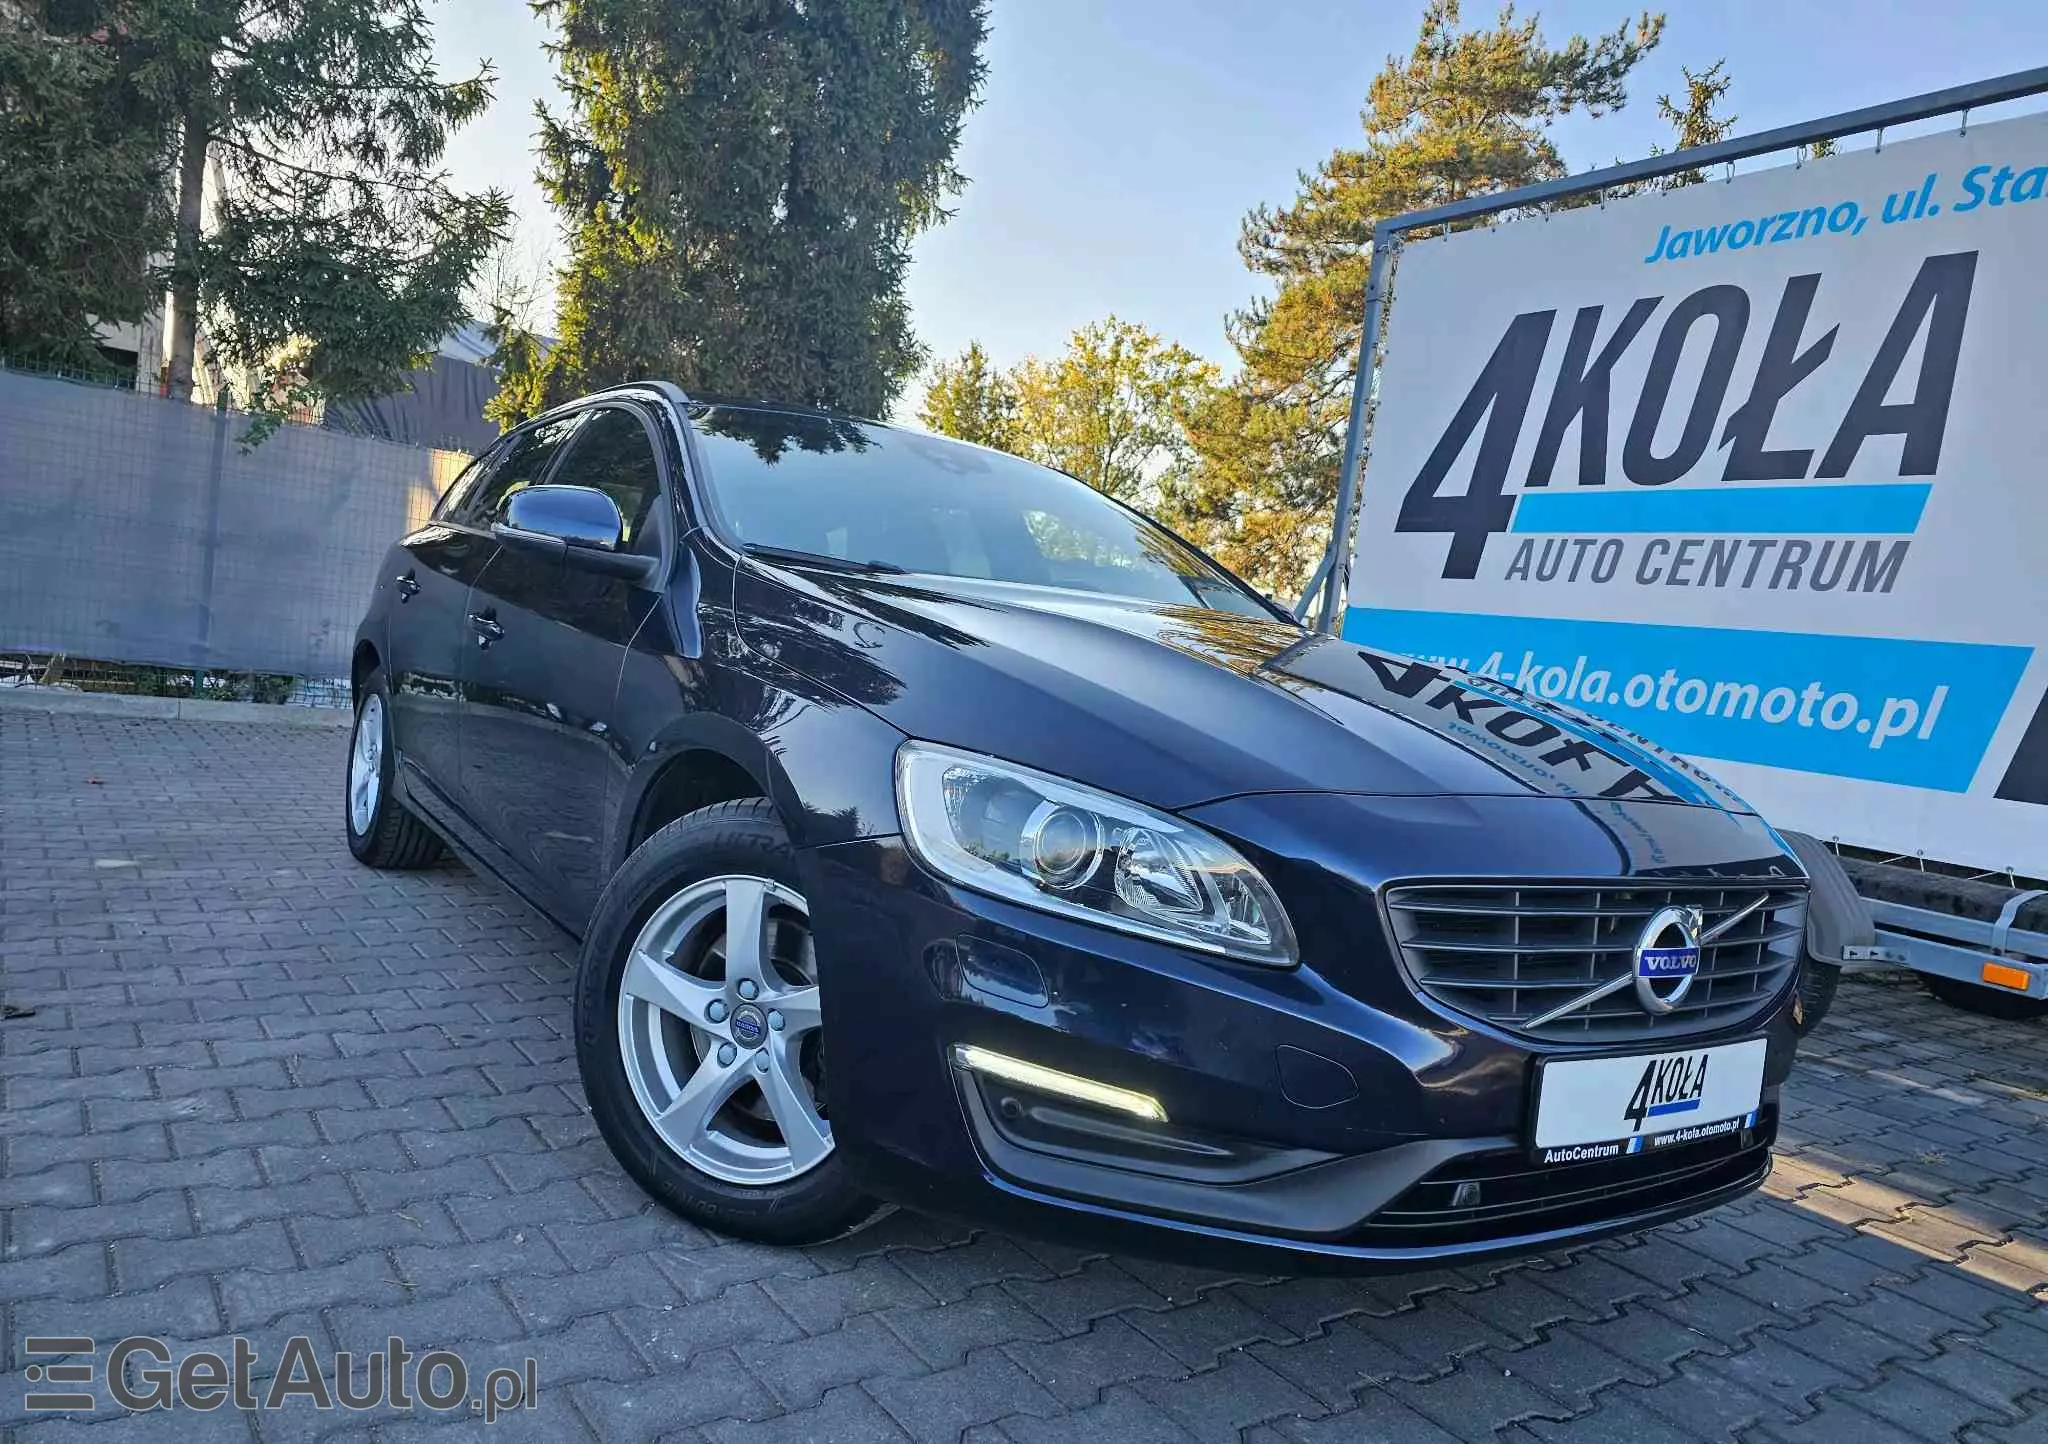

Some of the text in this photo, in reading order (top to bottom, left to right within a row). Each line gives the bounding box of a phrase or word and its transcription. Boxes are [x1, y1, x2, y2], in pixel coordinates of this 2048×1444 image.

[1645, 165, 2048, 264] Jaworzno, ul. Sta
[1395, 250, 1979, 580] 4KOŁA
[1505, 538, 1911, 594] AUTO CENTRUM
[1402, 650, 1949, 749] 4-kola.otomoto.pl
[1644, 954, 1697, 971] VOLVO
[1624, 1054, 1709, 1132] 4KOŁA
[1543, 1145, 1619, 1164] AutoCentrum
